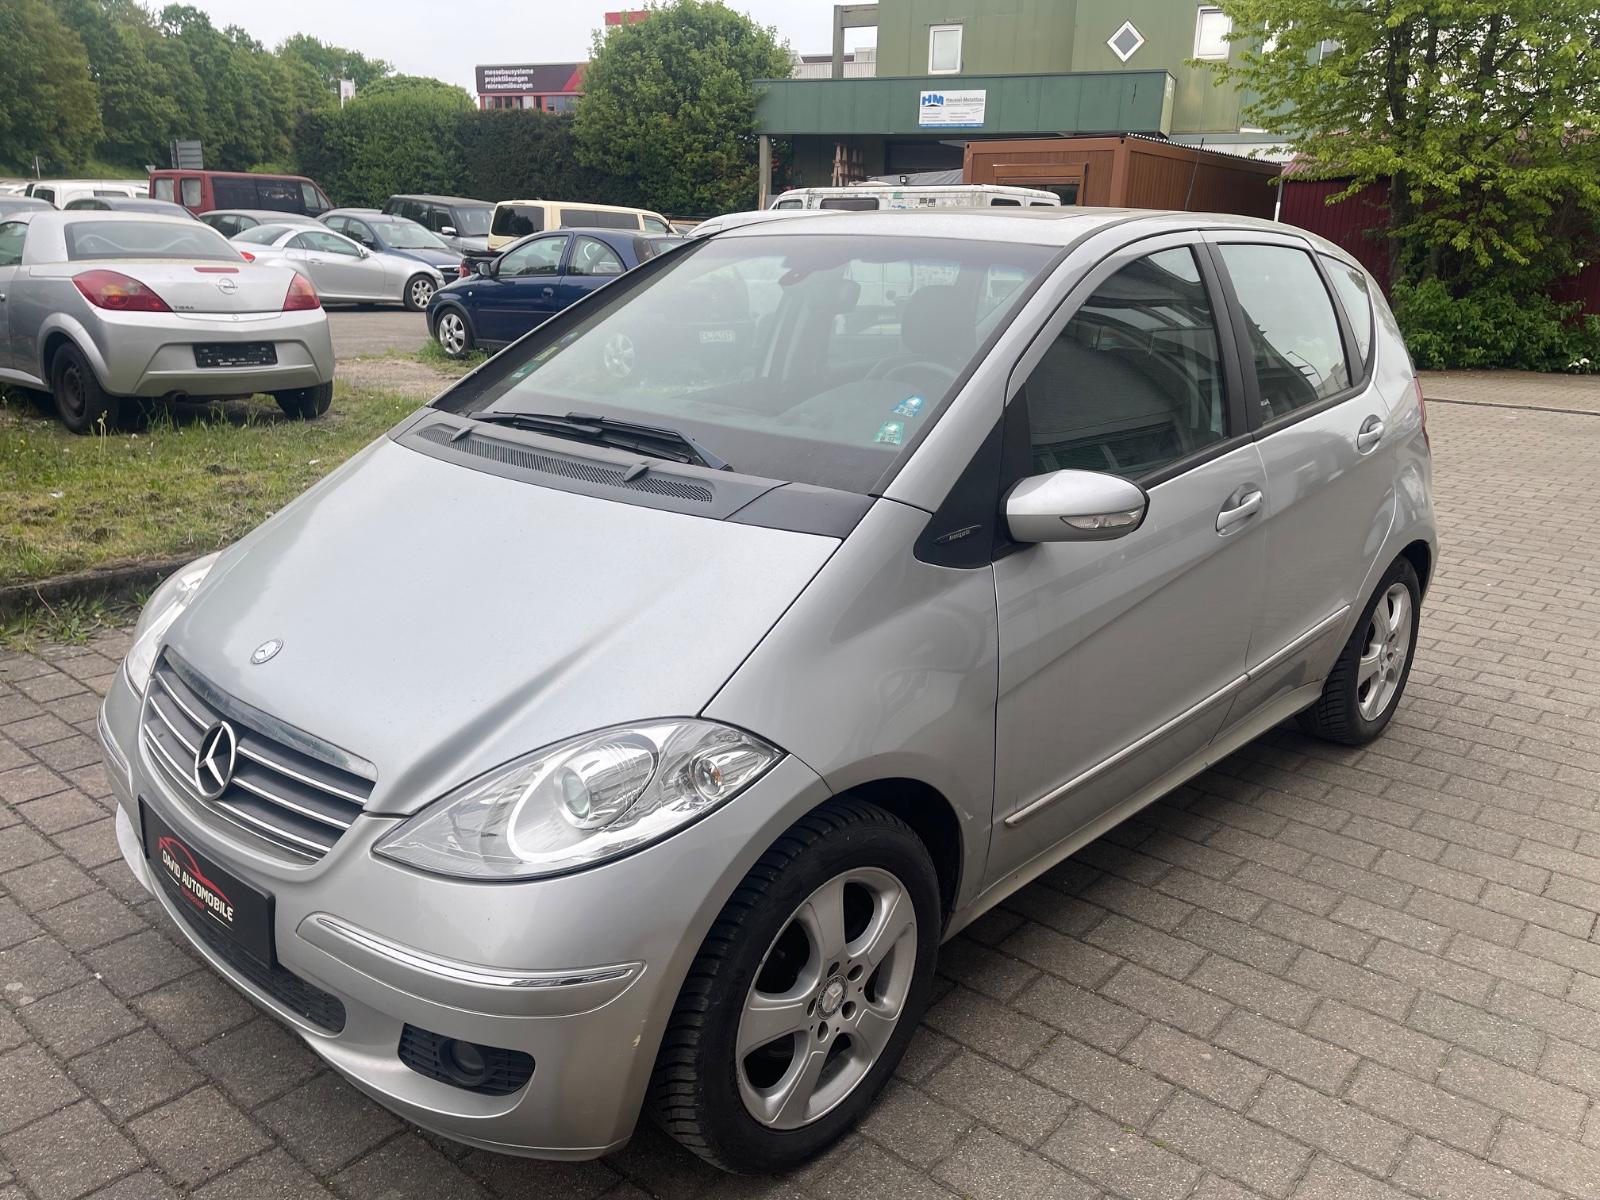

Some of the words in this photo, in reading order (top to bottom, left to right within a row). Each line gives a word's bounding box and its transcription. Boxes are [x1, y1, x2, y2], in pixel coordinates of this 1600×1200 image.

[484, 68, 534, 76] messebausysteme
[485, 75, 528, 83] projektlösungen
[922, 94, 944, 105] HM
[162, 848, 181, 878] DAVID
[181, 871, 234, 923] AUTOMOBILE
